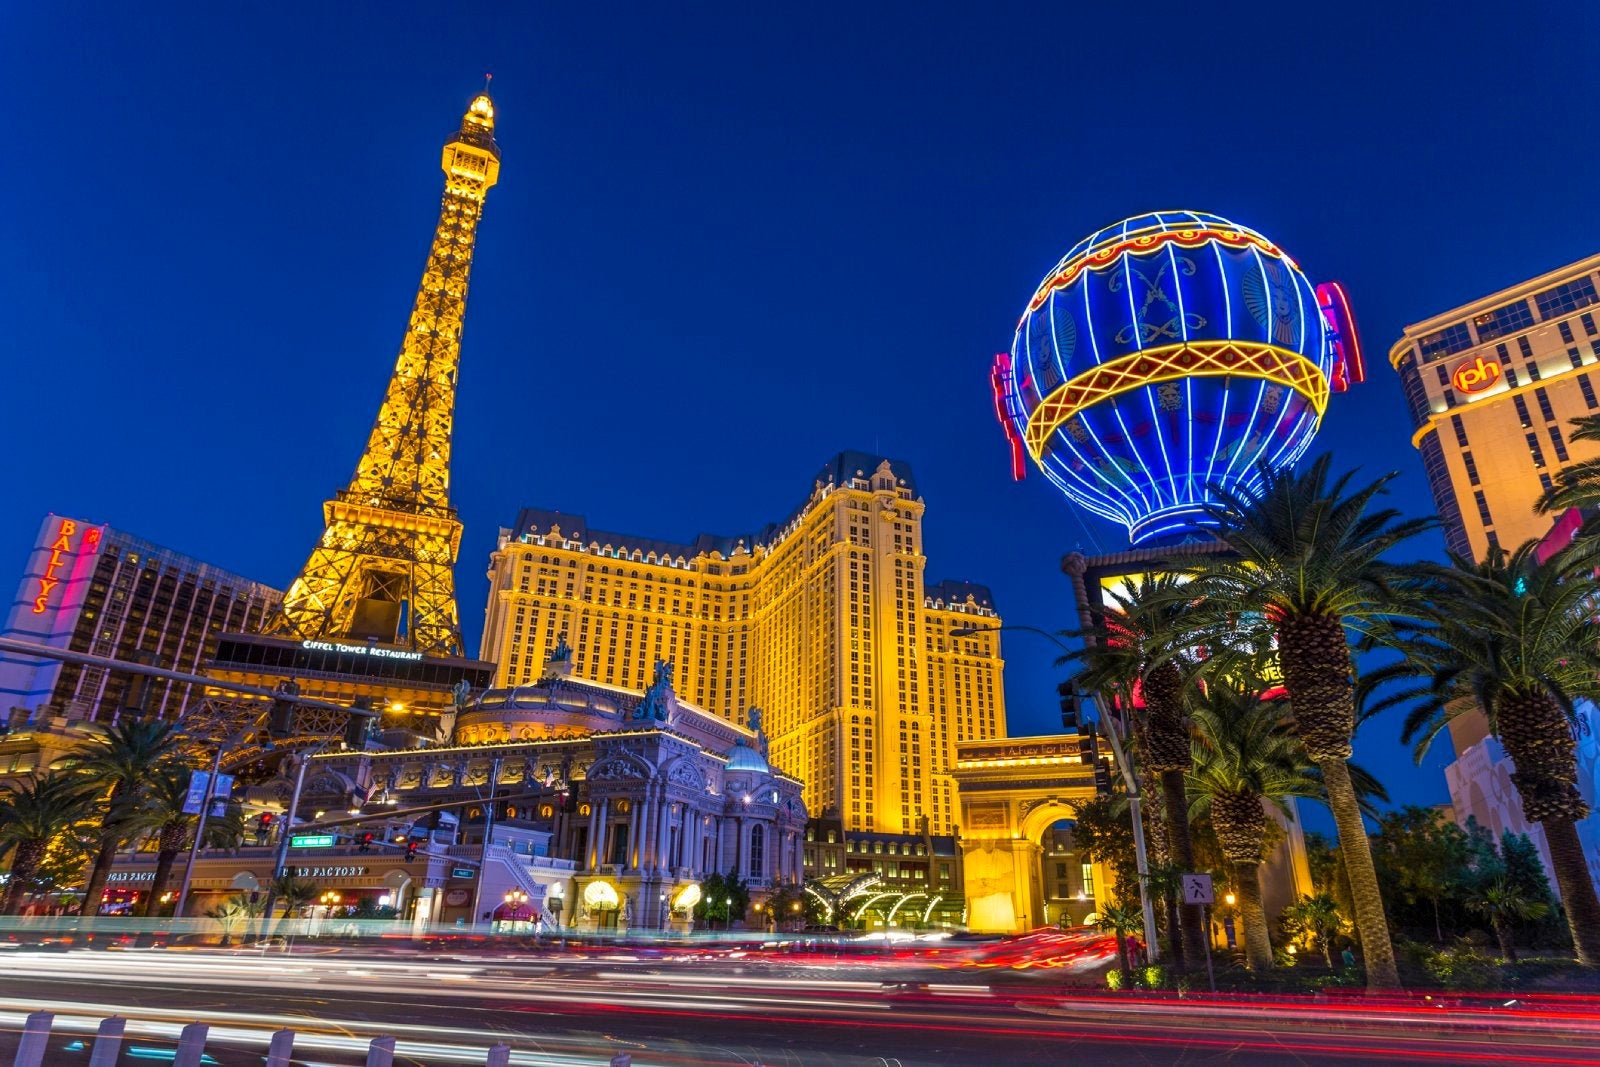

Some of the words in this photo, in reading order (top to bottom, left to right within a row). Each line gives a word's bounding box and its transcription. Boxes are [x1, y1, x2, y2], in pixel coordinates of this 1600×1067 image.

[335, 643, 366, 655] TOWER
[369, 647, 423, 661] RESTAURANT
[312, 866, 364, 877] FACTORY
